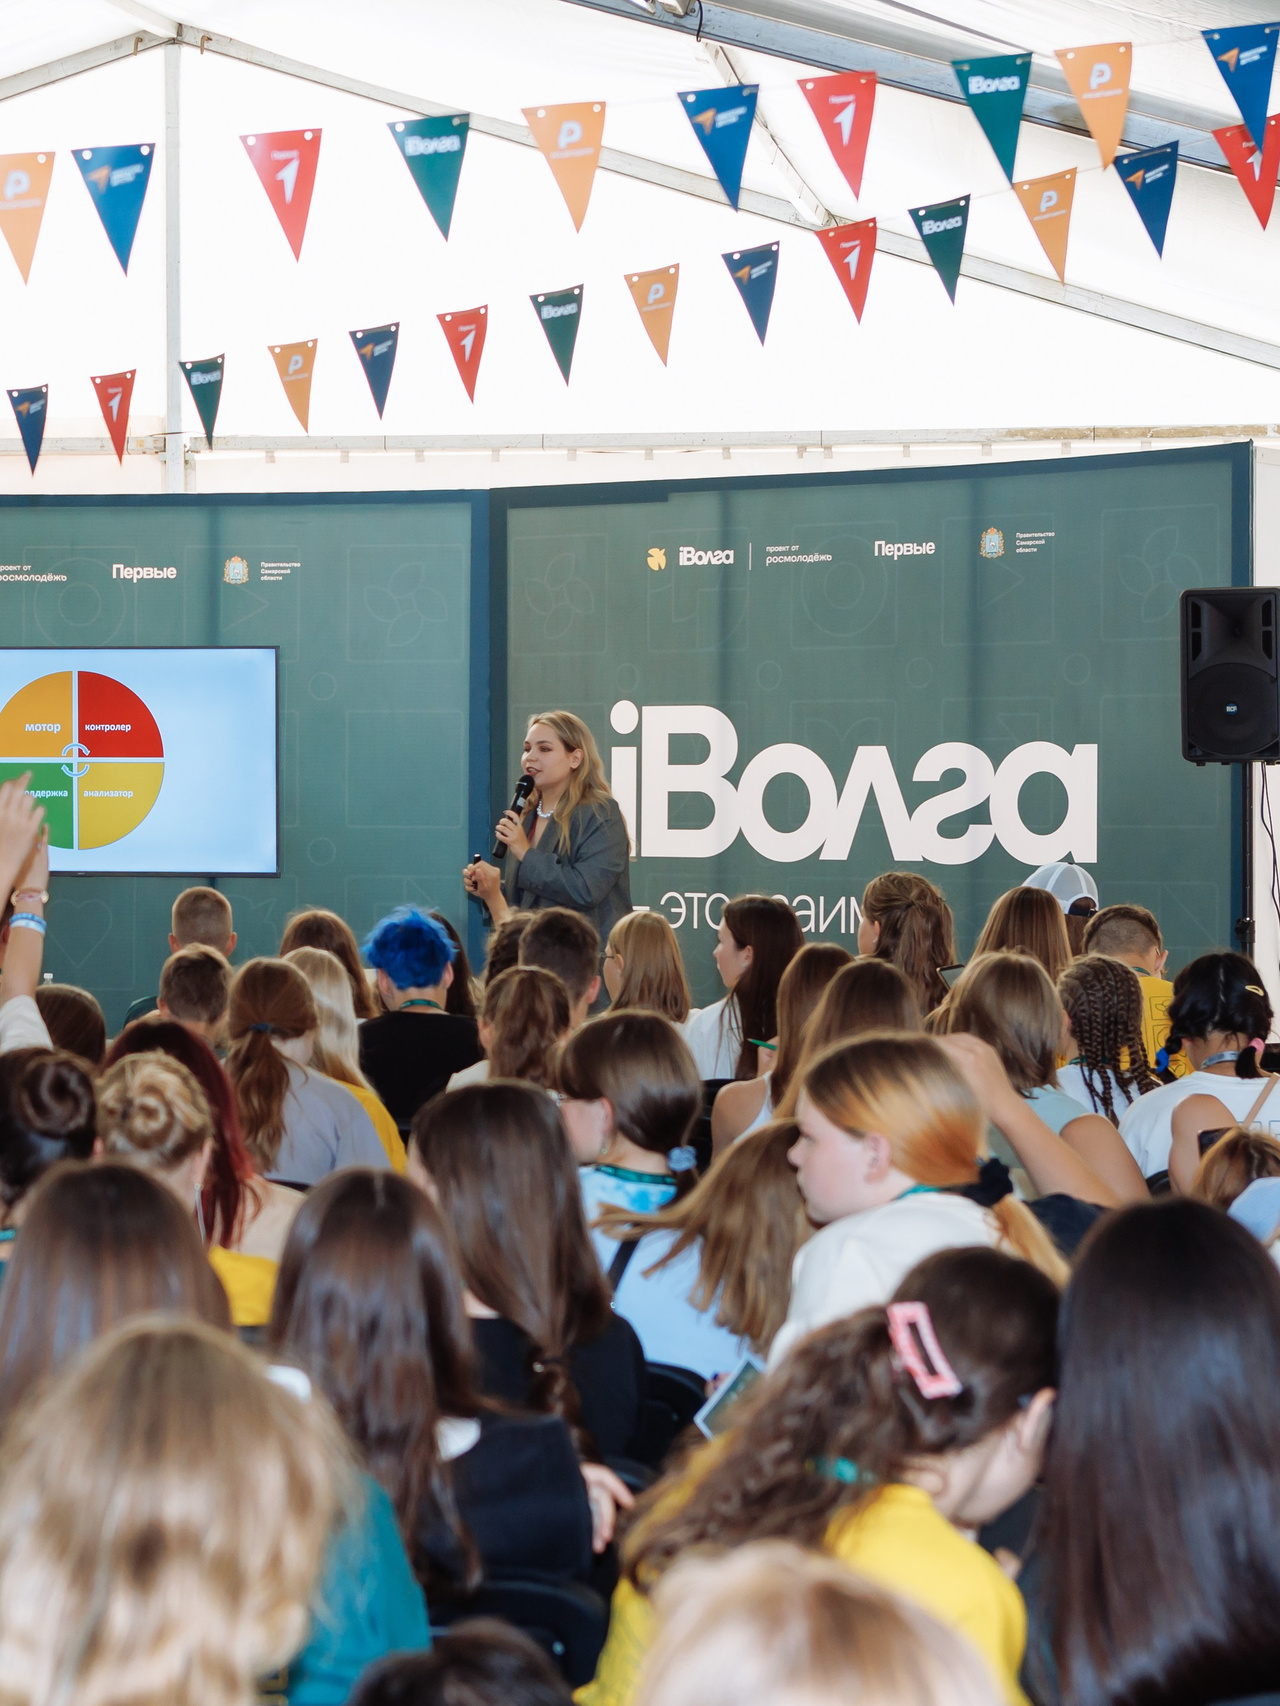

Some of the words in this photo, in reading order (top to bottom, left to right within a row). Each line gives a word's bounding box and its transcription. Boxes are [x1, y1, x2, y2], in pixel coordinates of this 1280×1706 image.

[679, 546, 735, 566] iВолга
[766, 545, 789, 553] проект
[874, 540, 936, 560] Первые
[766, 553, 832, 567] росмолодёжь
[112, 563, 177, 583] Первые
[25, 723, 61, 734] мотор
[84, 724, 131, 733] контролер
[610, 700, 1098, 865] iВолга
[24, 790, 68, 798] оддержка
[83, 790, 134, 798] анализатор
[660, 892, 730, 929] это
